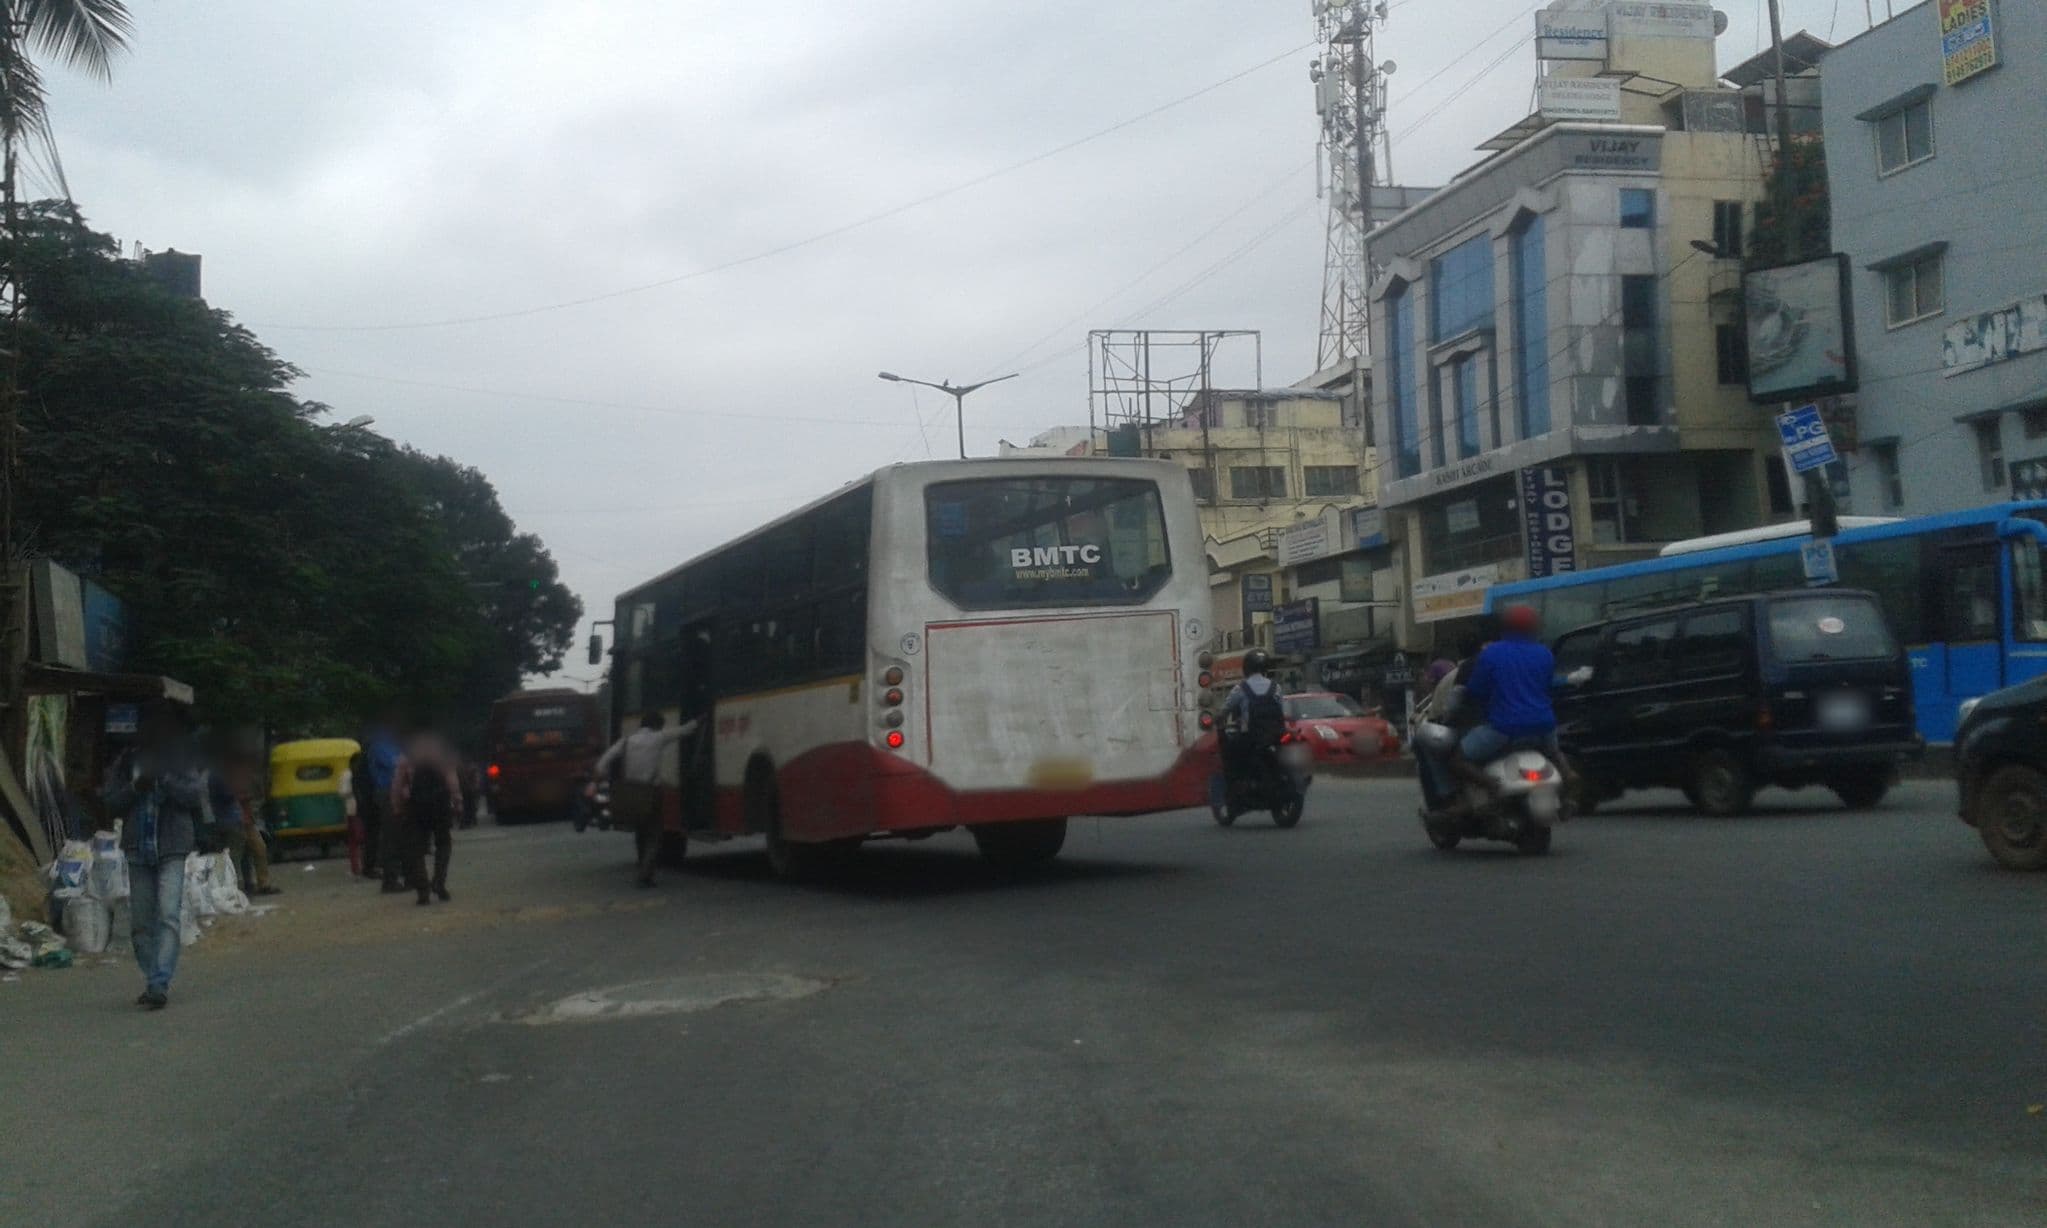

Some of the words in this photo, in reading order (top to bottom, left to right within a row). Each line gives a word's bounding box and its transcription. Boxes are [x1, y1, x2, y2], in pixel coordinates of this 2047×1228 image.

[1942, 1, 1987, 34] LADIES
[1590, 139, 1640, 153] VIJAY
[1575, 155, 1649, 164] RESIDENCY
[1796, 421, 1825, 440] PG
[1543, 468, 1573, 575] LODGE
[1010, 544, 1101, 568] BMTC
[1015, 566, 1089, 581] www.mybmtc.com
